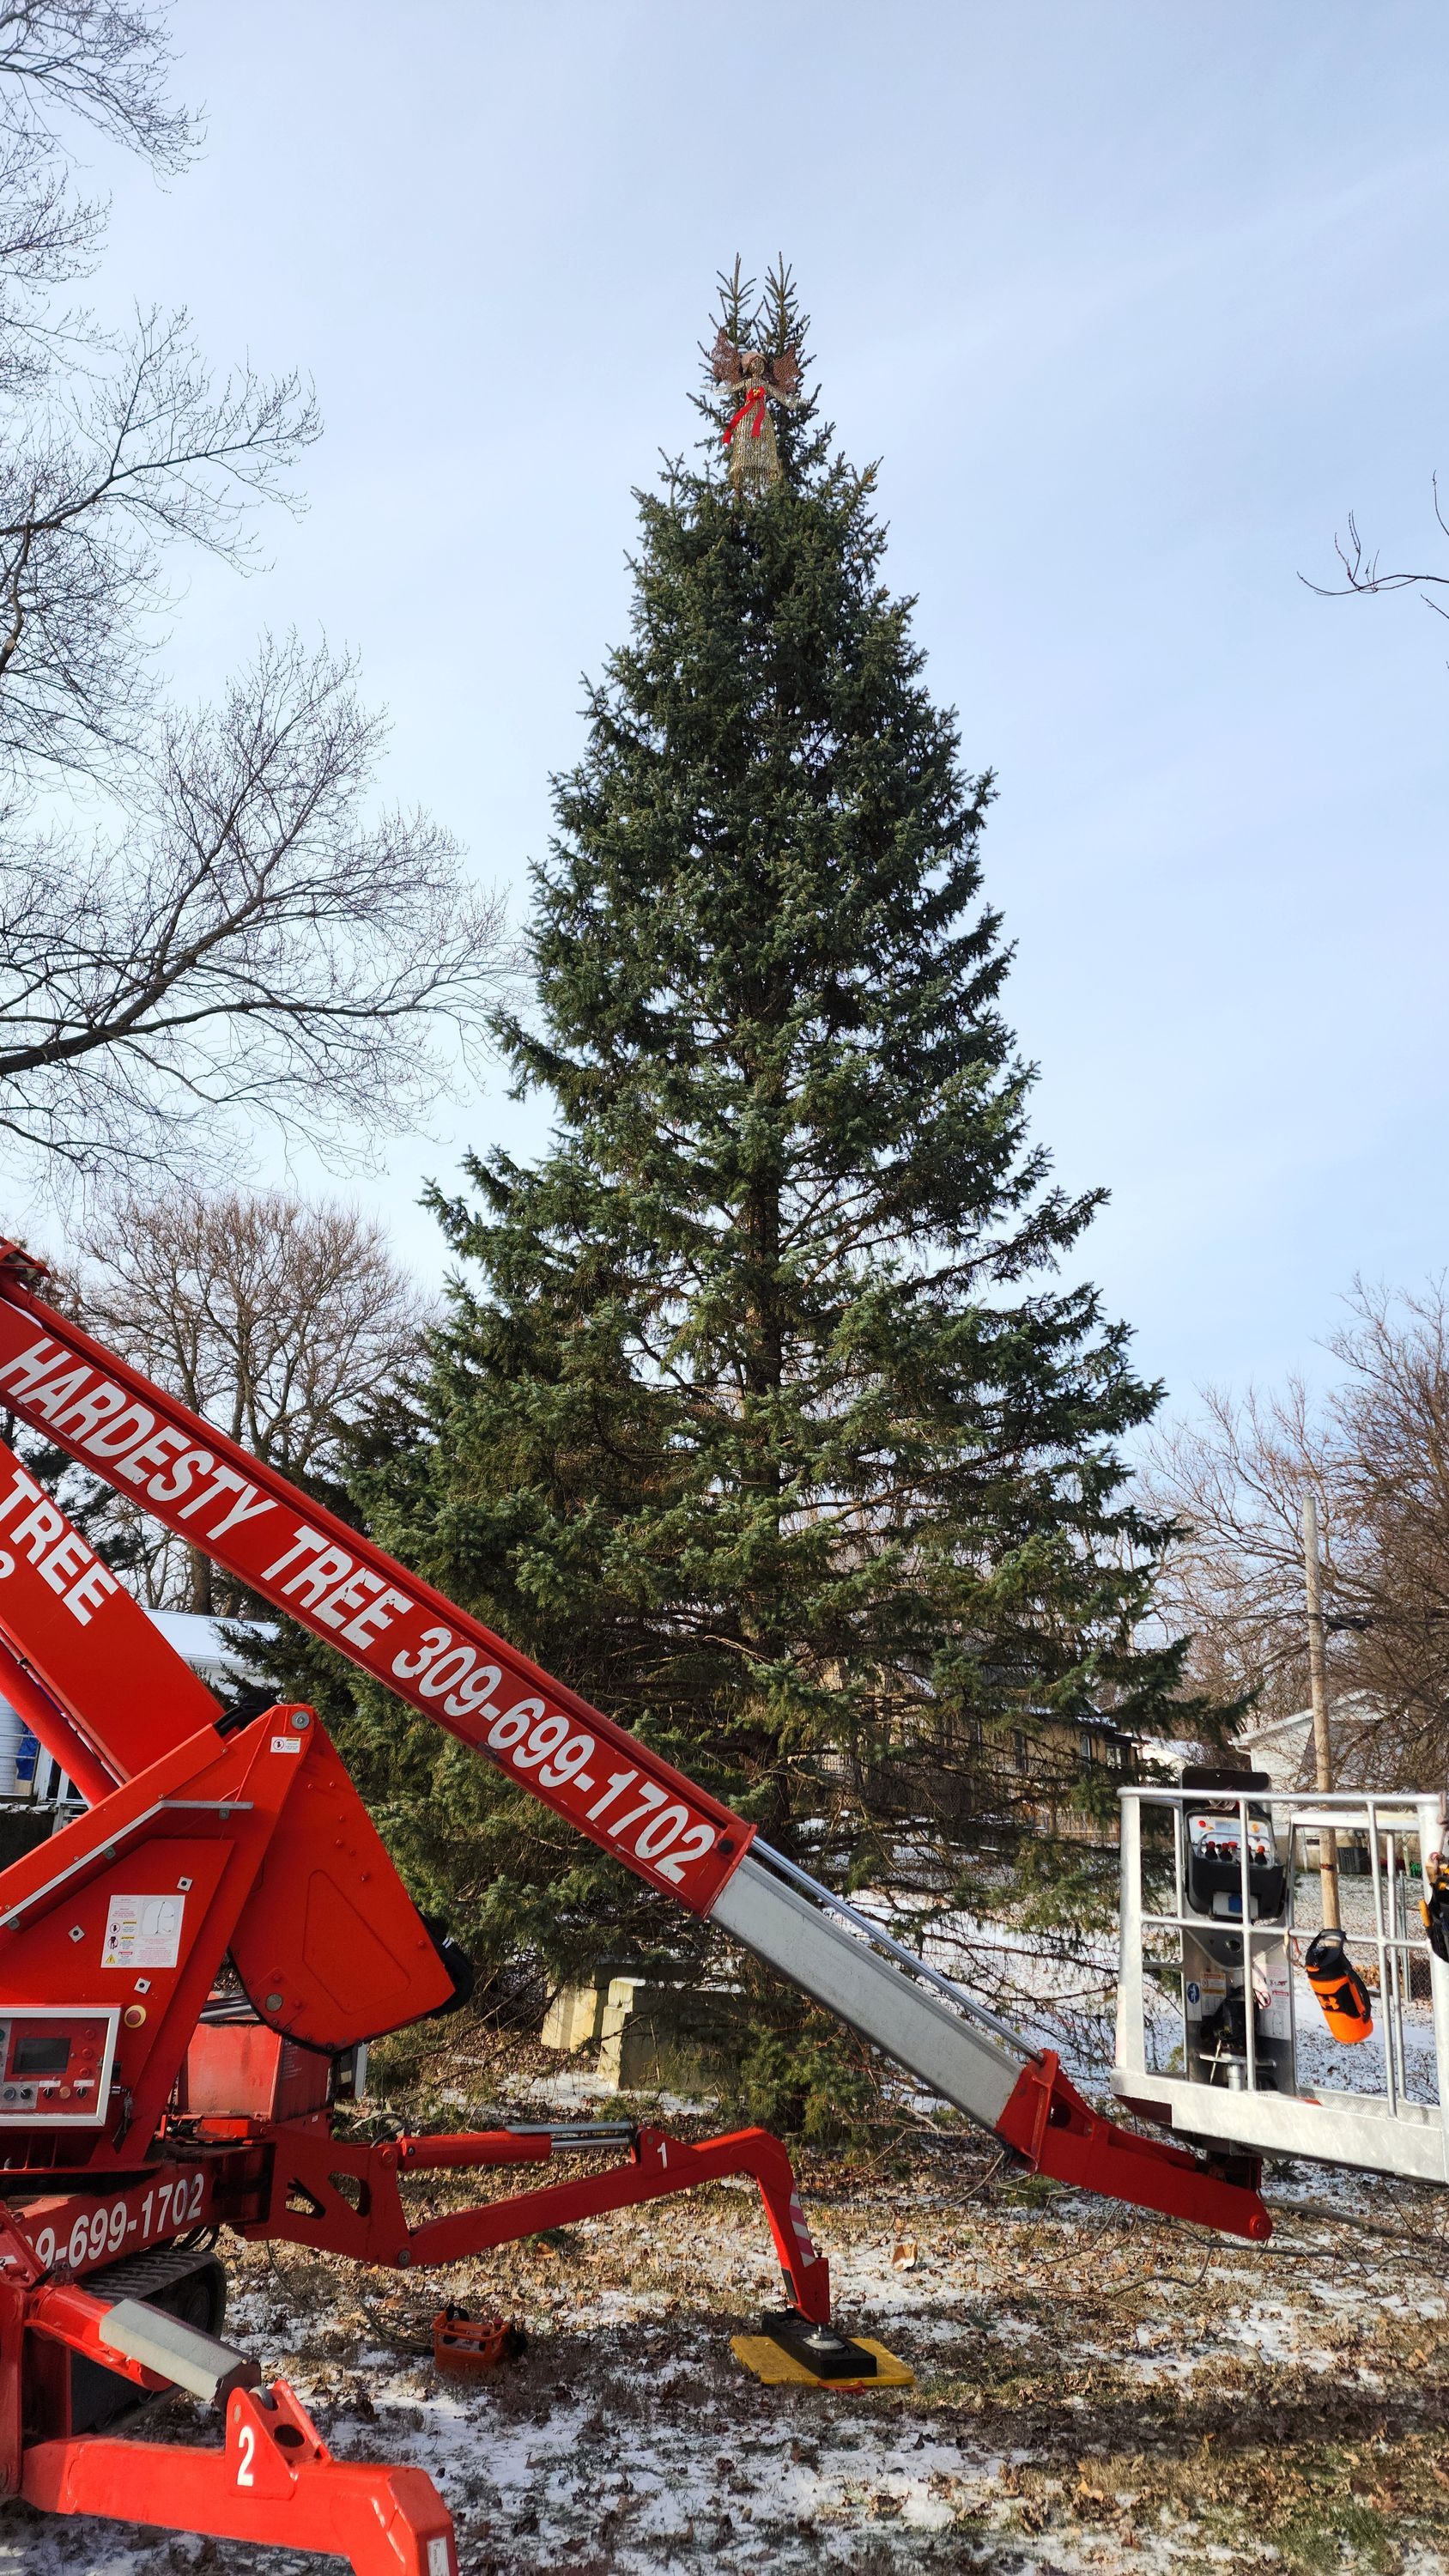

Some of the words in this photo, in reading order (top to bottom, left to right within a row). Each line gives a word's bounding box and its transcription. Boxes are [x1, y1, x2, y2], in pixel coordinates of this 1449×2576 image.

[0, 1467, 120, 1627] TREE
[0, 1337, 279, 1541] HARDESTY
[260, 1524, 415, 1650] TREE
[391, 1627, 716, 1884] 309-699-1702
[657, 2142, 668, 2169] 1
[25, 2172, 204, 2269] 9-699-1702
[237, 2425, 255, 2487] 2
